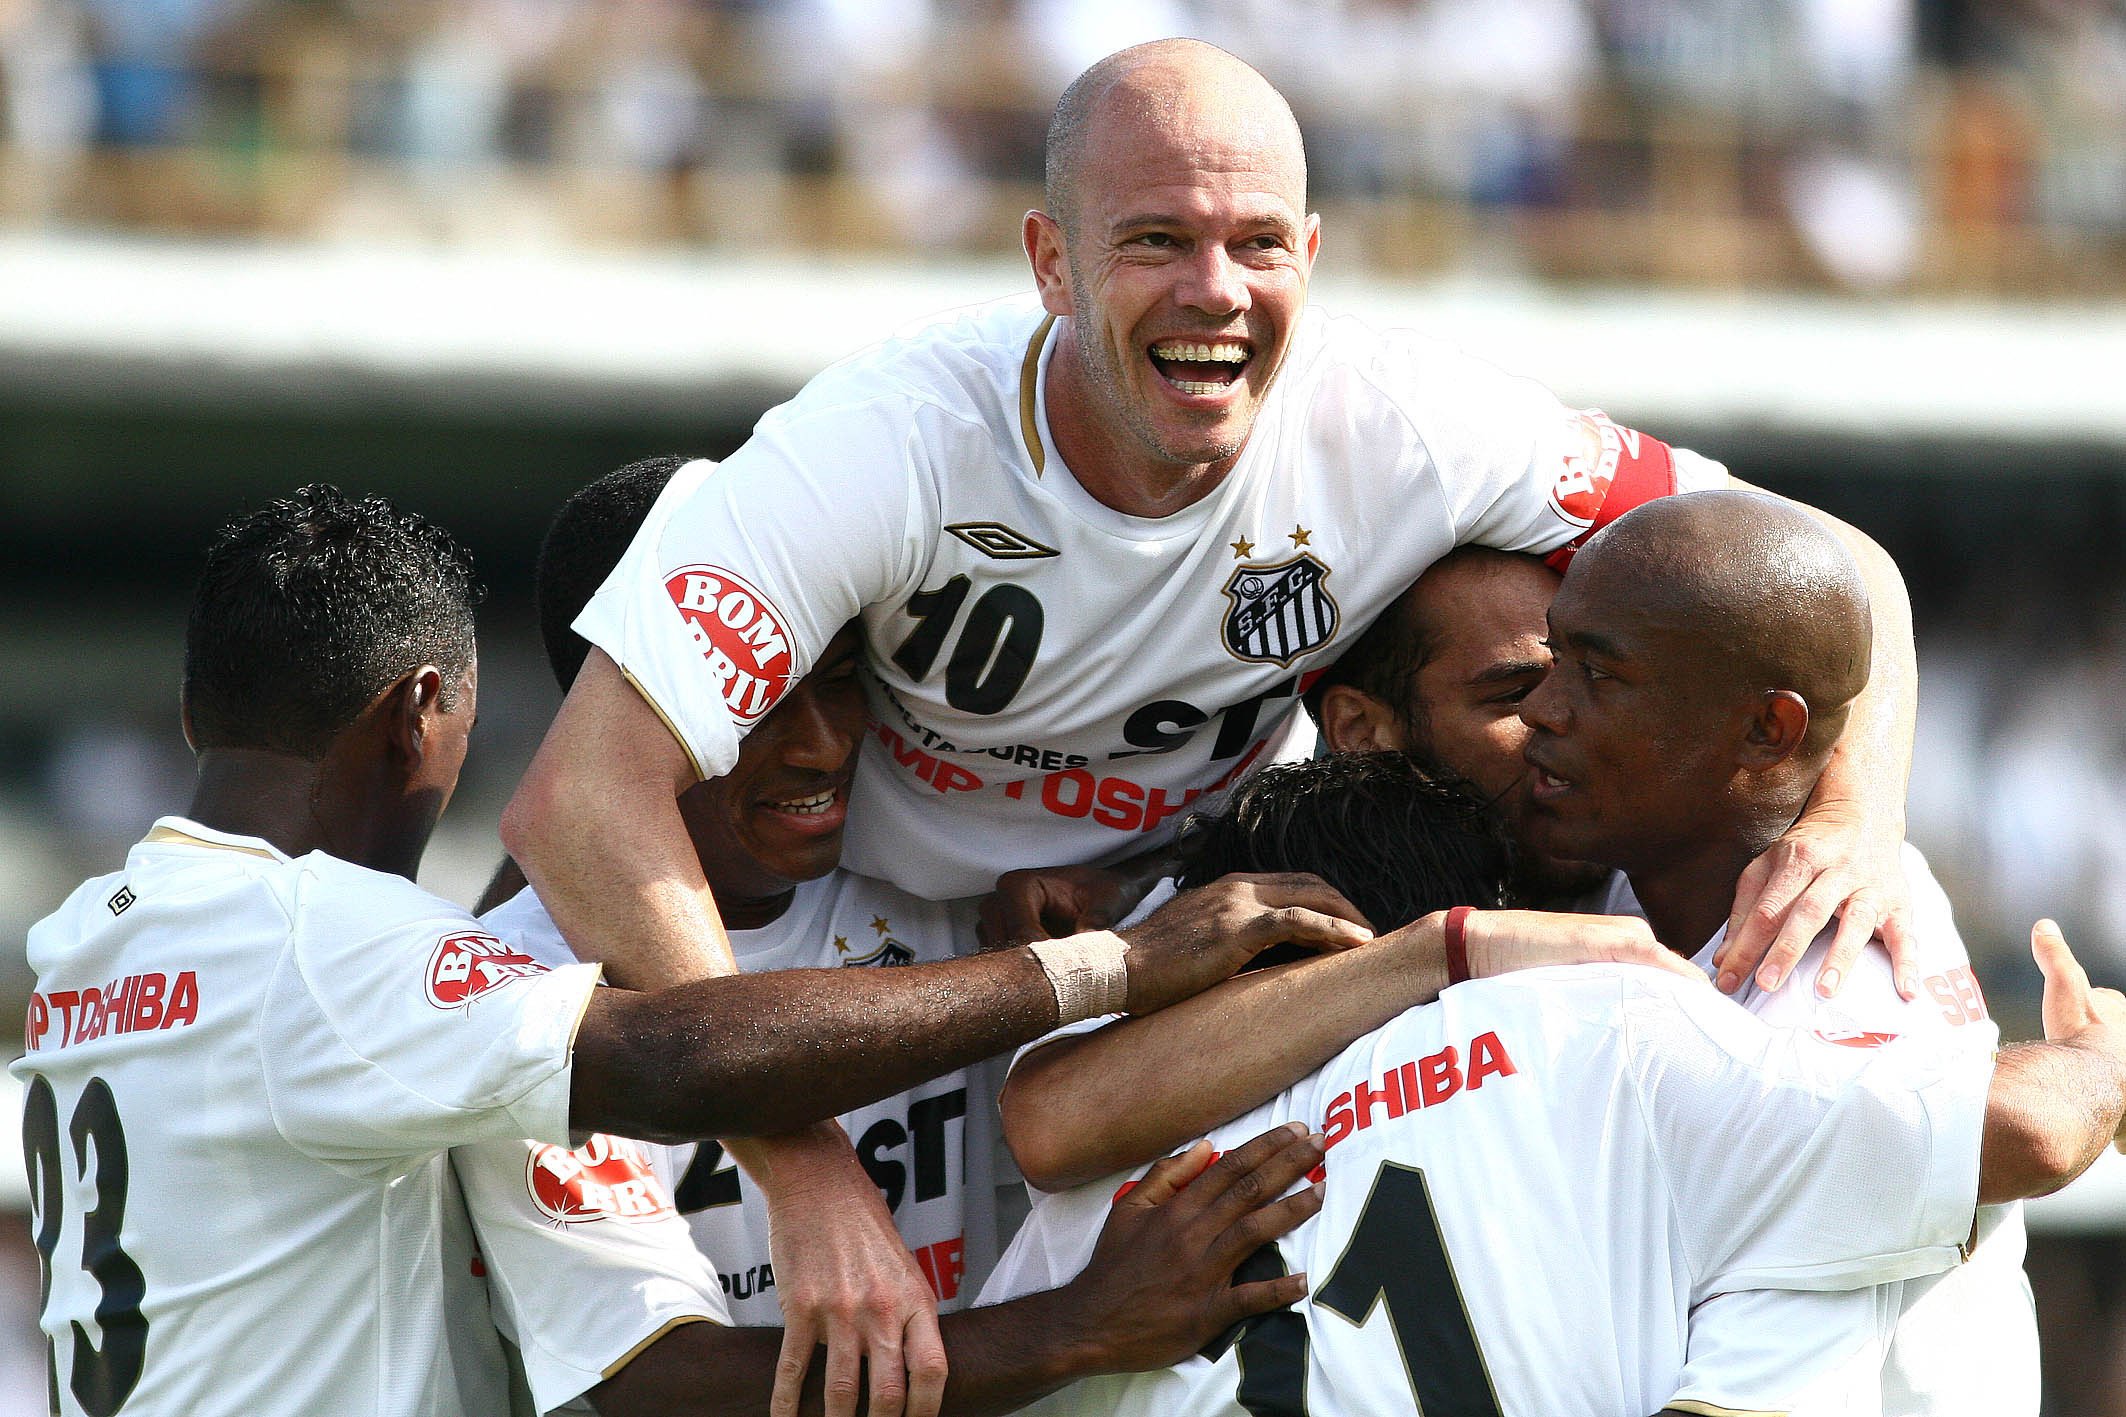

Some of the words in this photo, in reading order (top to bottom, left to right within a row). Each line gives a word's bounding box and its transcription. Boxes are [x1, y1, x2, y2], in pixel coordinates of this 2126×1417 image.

[678, 574, 788, 670] BOM
[892, 573, 1044, 715] 10
[1322, 1031, 1518, 1152] SHIBA
[22, 1073, 149, 1417] 23
